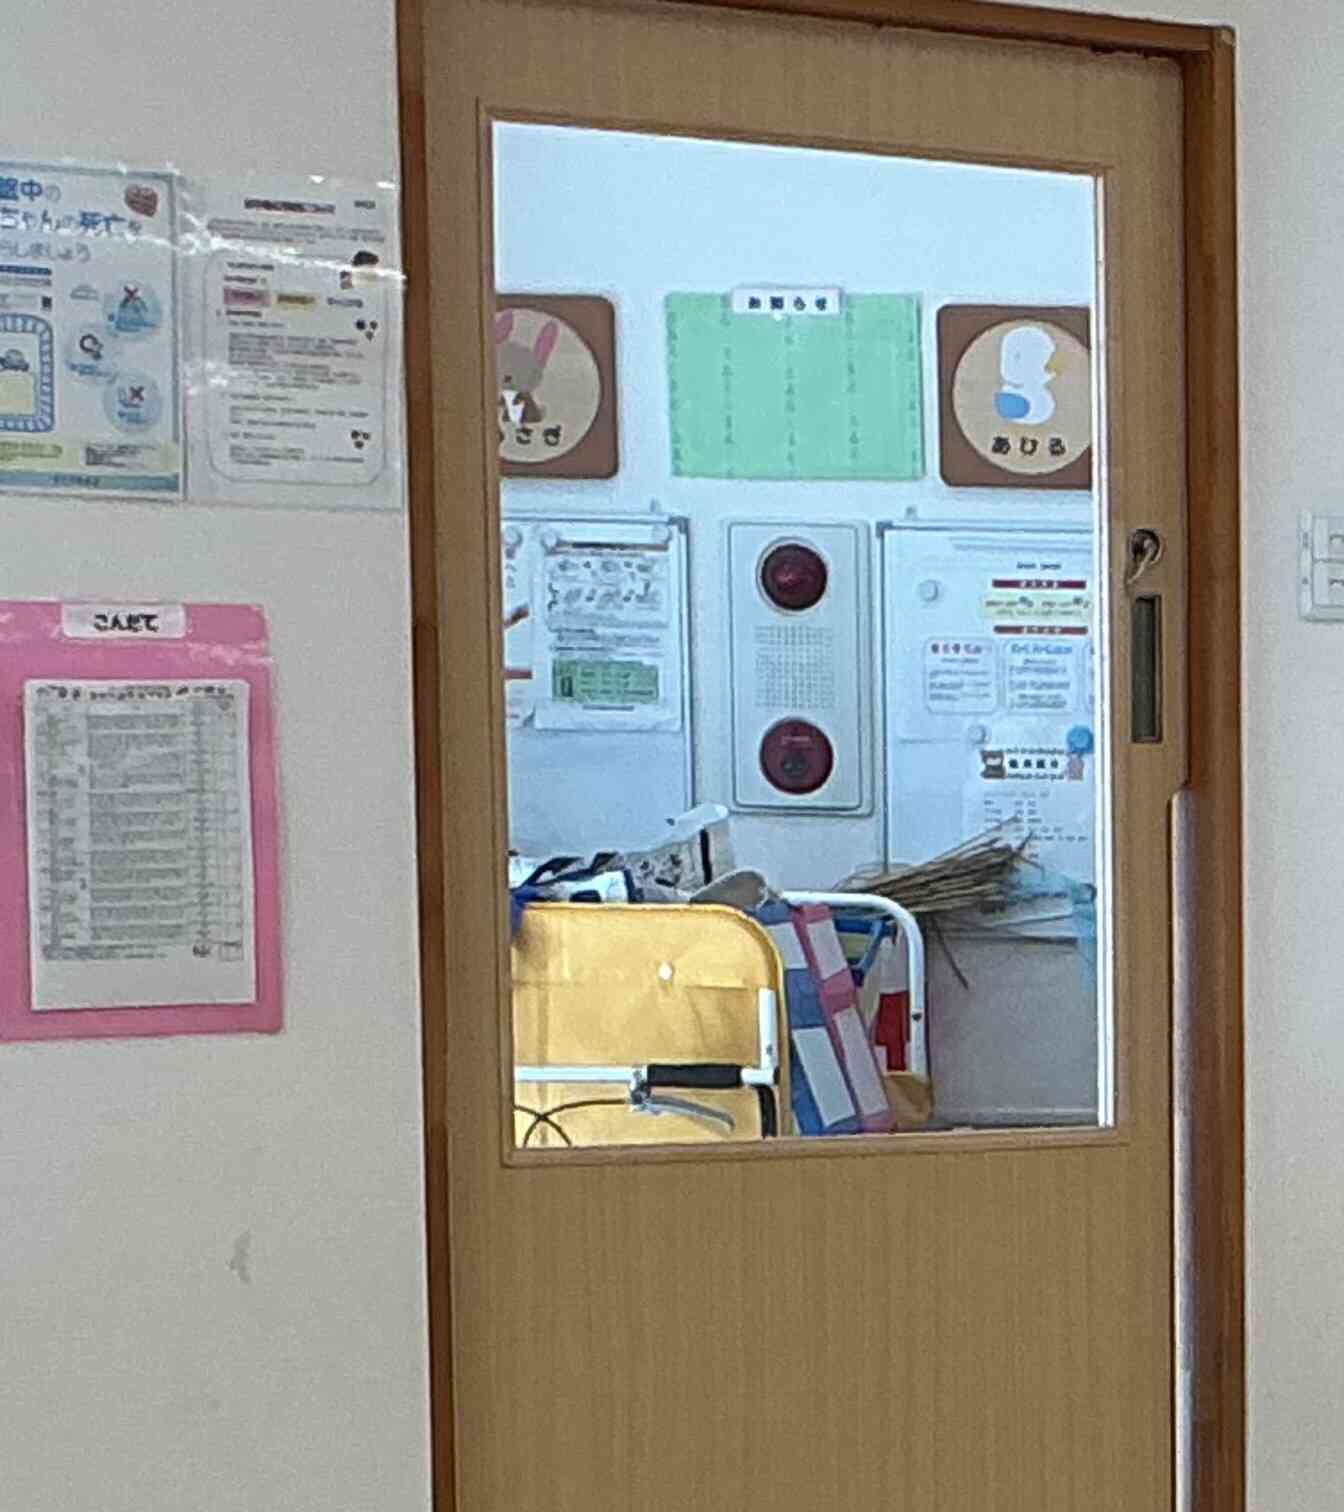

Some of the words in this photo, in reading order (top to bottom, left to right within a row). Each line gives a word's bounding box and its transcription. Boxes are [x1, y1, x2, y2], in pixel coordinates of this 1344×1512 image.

[499, 424, 562, 447] さぎ
[991, 436, 1066, 457] あひる
[93, 612, 159, 633] こんだて
